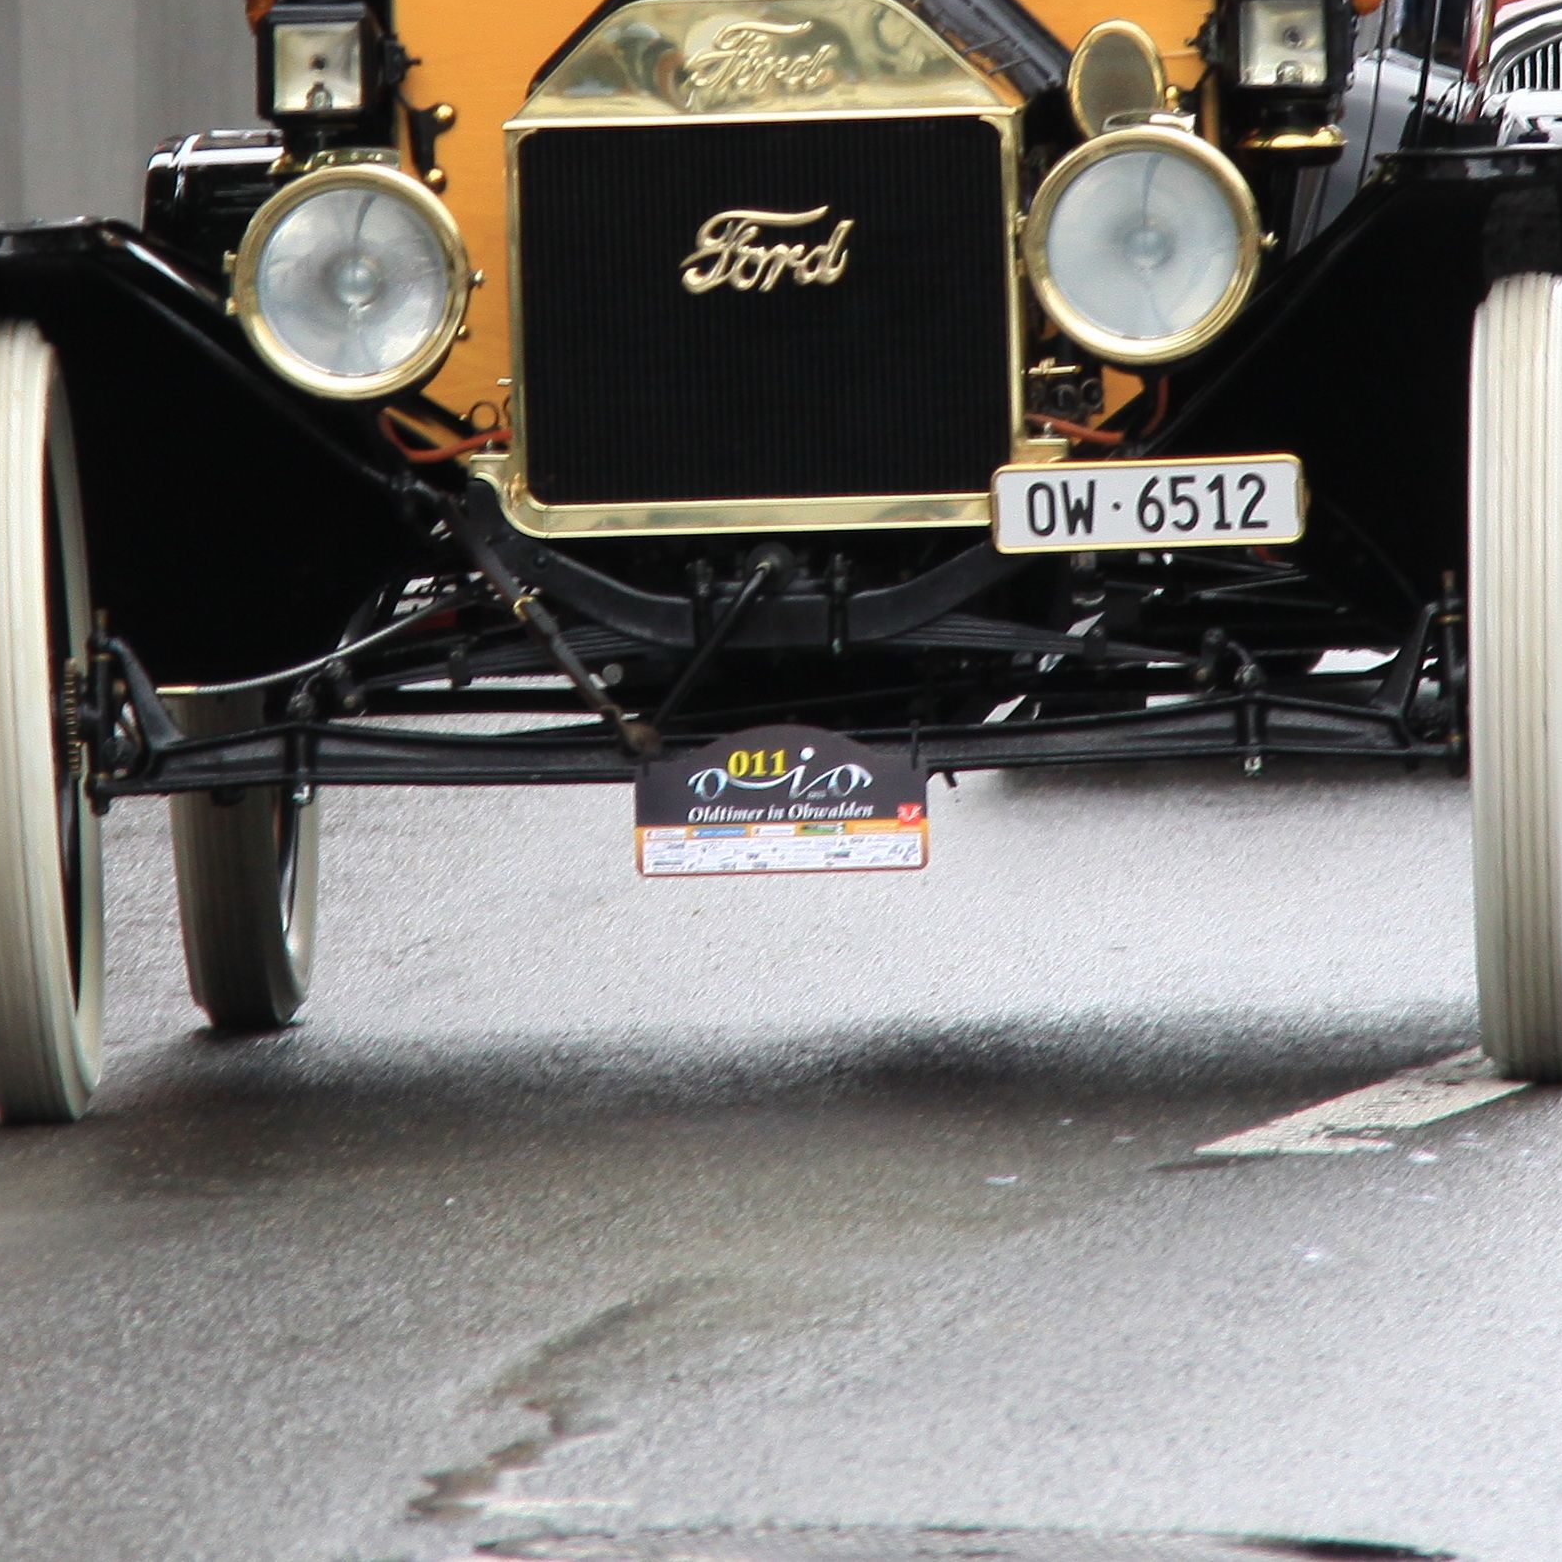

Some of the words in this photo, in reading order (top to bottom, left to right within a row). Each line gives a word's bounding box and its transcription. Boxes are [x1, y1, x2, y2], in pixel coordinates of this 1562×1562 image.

[683, 20, 839, 90] Ford
[680, 205, 855, 295] Ford
[1137, 472, 1269, 533] 6512
[727, 749, 786, 778] 011
[688, 805, 765, 824] Oldtimer
[768, 804, 785, 822] in
[788, 801, 874, 820] Obwalden
